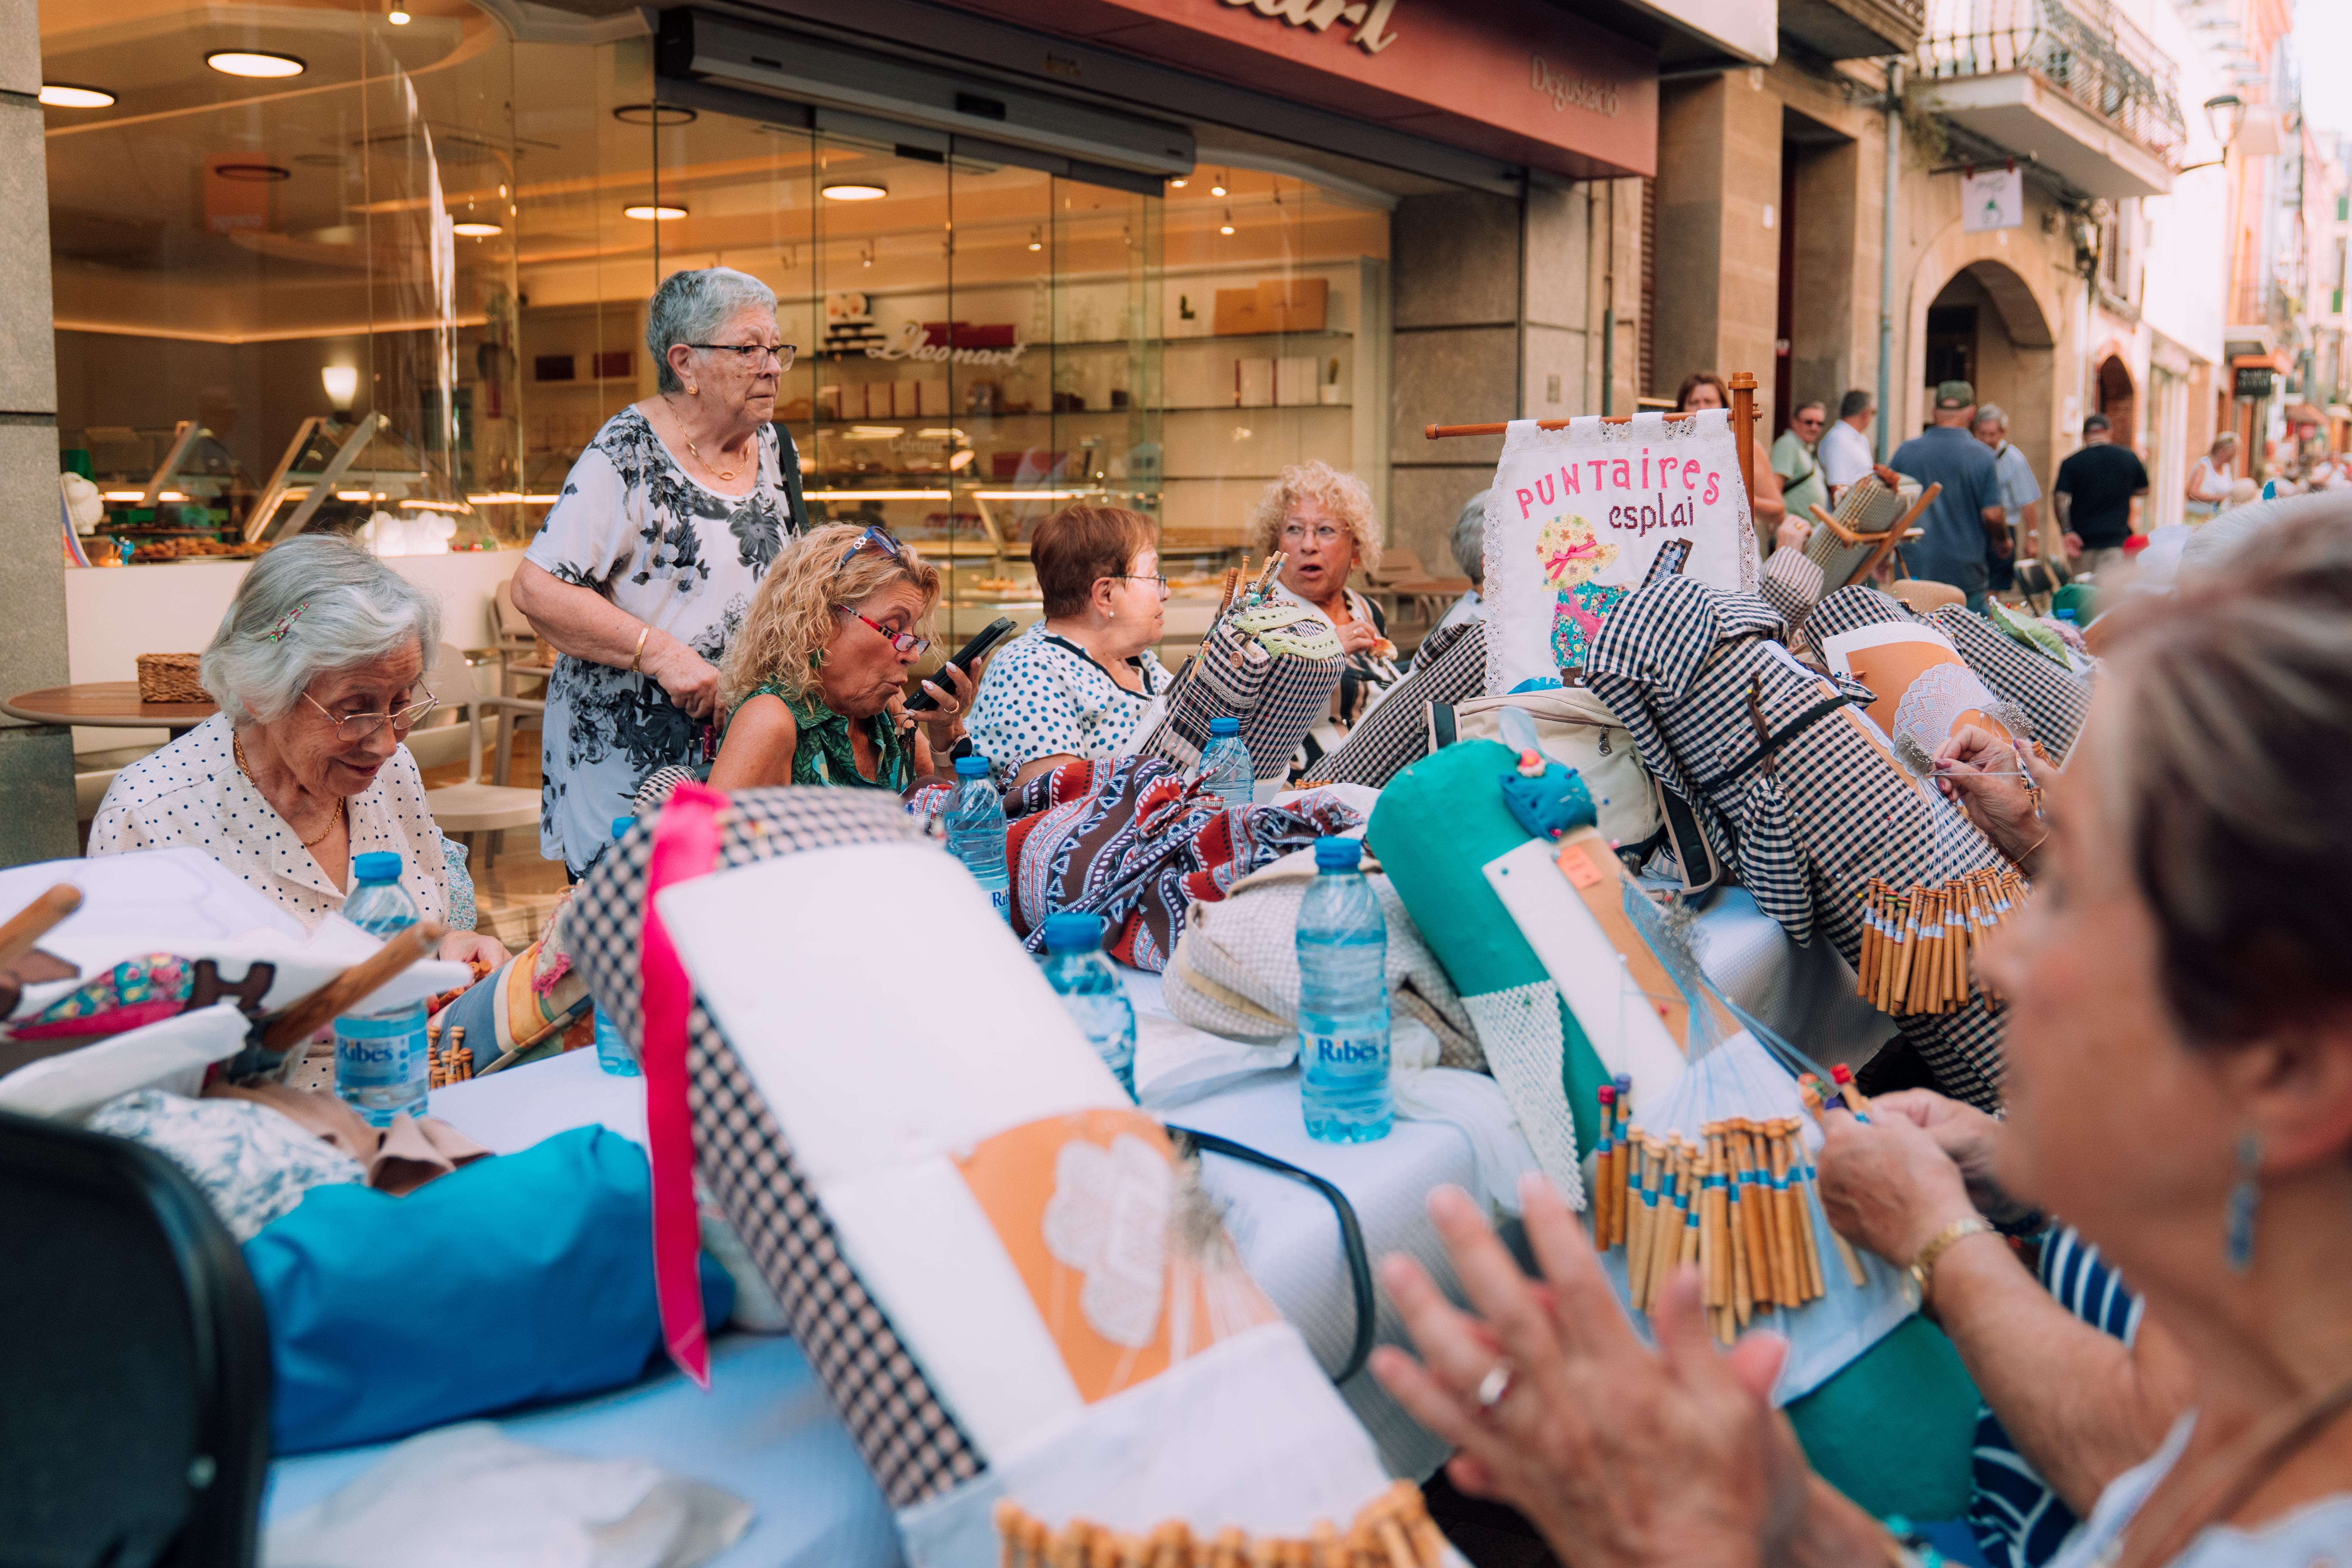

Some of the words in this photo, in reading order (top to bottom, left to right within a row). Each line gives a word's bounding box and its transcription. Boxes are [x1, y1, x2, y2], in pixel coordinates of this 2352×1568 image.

[1532, 55, 1620, 118] Degustació
[865, 323, 1027, 367] Lleonart
[1515, 448, 1720, 520] PUNTaires
[1609, 492, 1694, 538] esplai
[992, 889, 1010, 907] Rib
